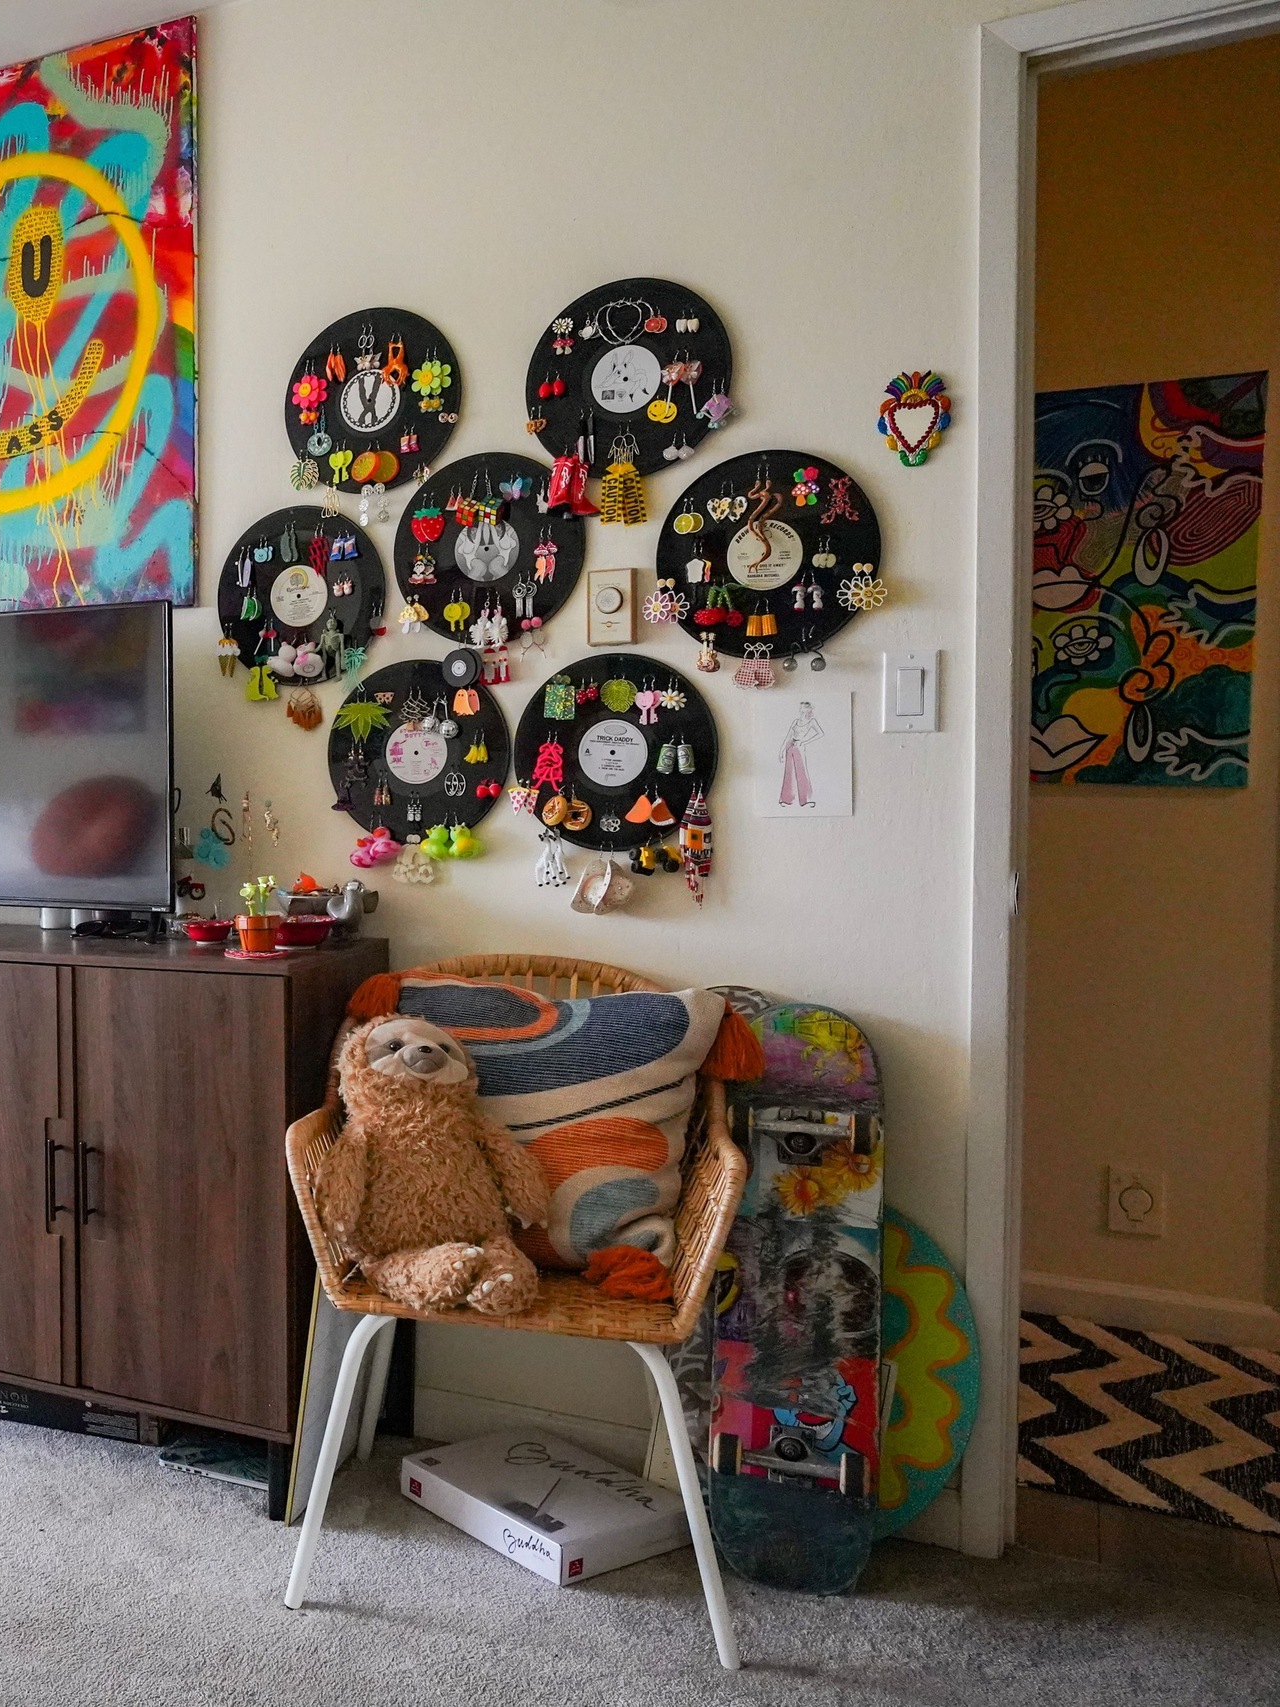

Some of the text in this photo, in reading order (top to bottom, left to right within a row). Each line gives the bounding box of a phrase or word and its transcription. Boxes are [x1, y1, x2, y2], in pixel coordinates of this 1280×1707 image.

[22, 235, 52, 298] U
[7, 410, 63, 454] ASS
[605, 477, 619, 523] CAUTION
[623, 477, 641, 524] CAUTION
[505, 1442, 657, 1512] Buddha
[503, 1528, 555, 1561] Buddha
